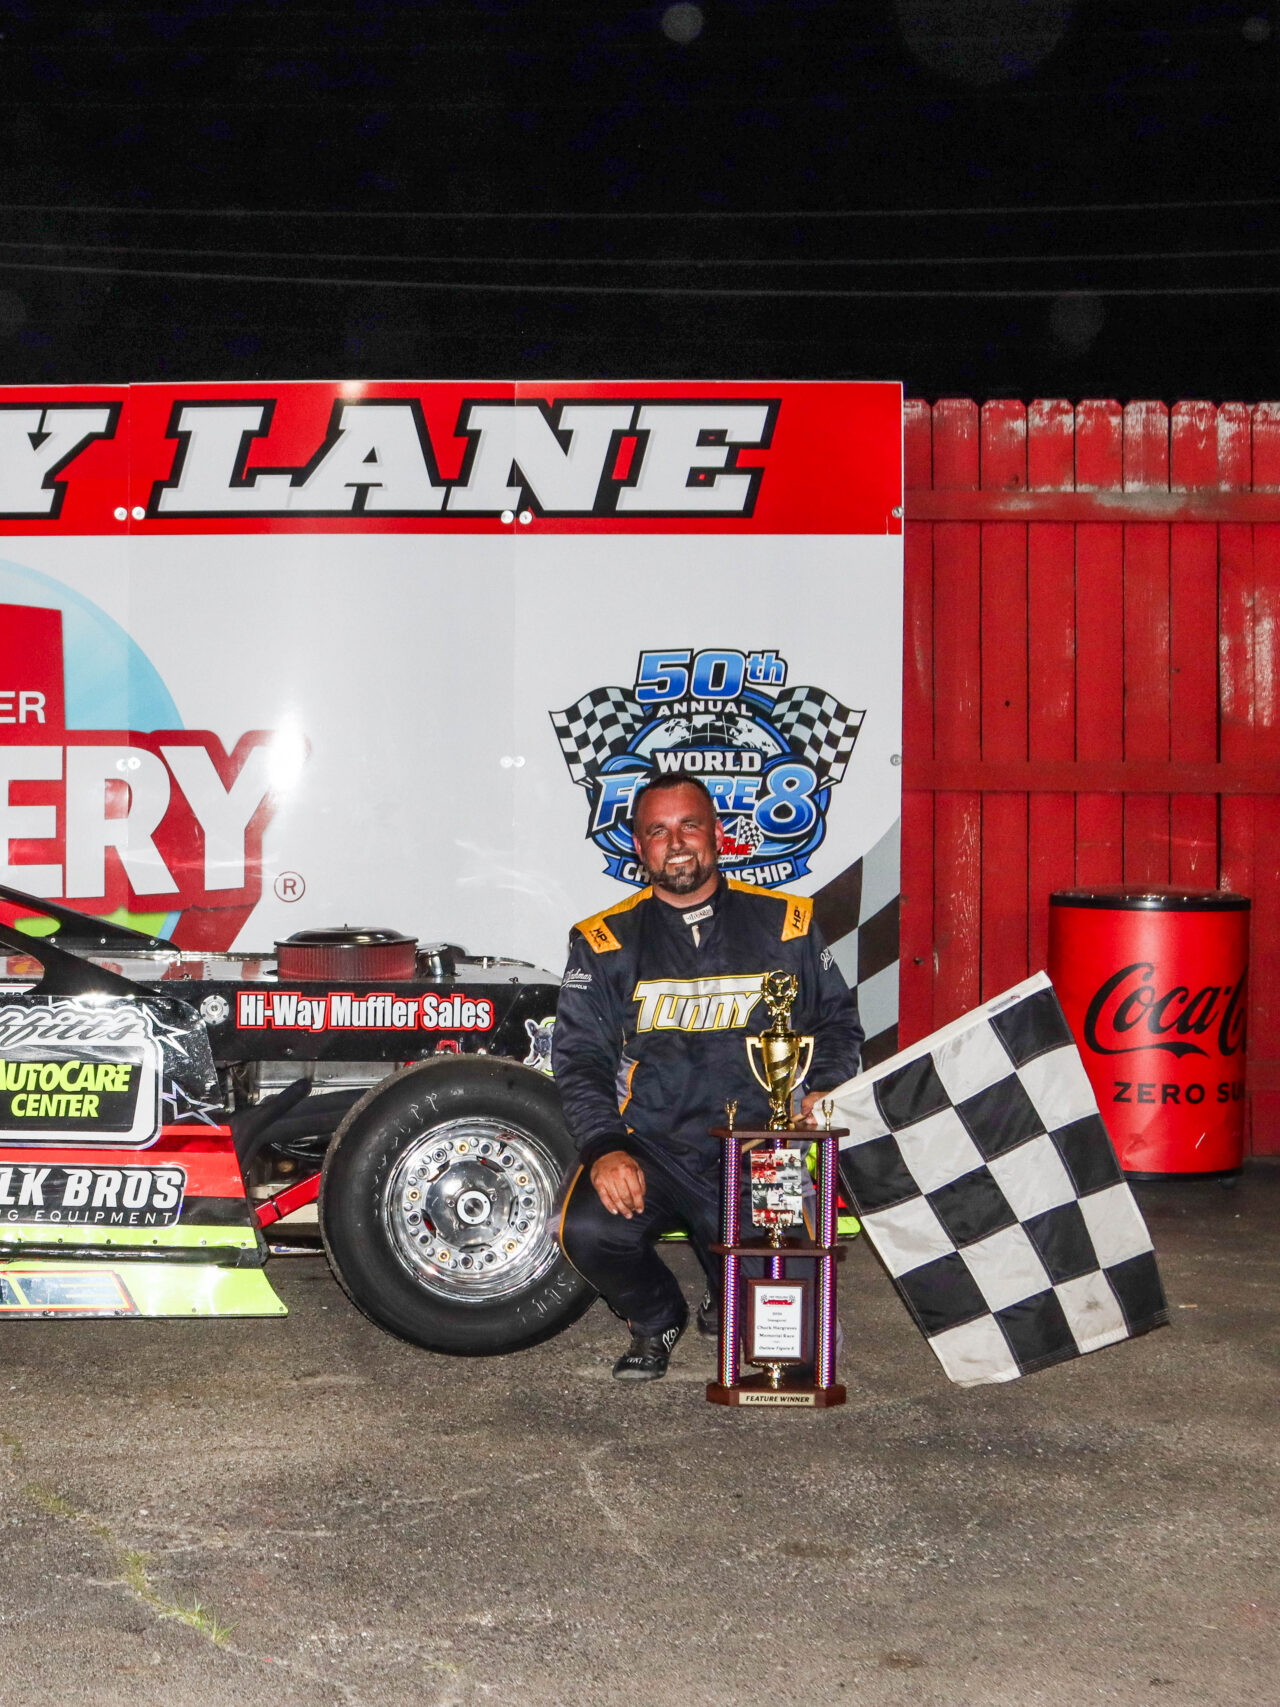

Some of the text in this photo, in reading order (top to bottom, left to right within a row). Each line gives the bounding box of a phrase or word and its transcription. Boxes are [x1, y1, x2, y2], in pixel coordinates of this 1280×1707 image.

[148, 398, 782, 518] LANE
[634, 648, 788, 702] 50th
[656, 700, 753, 717] ANNUAL
[654, 751, 762, 774] WORLD
[592, 763, 818, 838] FRE 8
[622, 859, 793, 886] CHNSHIP
[238, 994, 492, 1030] Hi-Way Muffler Sales
[10, 1093, 100, 1118] CENTER
[1113, 1081, 1206, 1105] ZERO
[55, 1168, 185, 1209] BROS
[34, 1210, 181, 1224] EQUIPMENT
